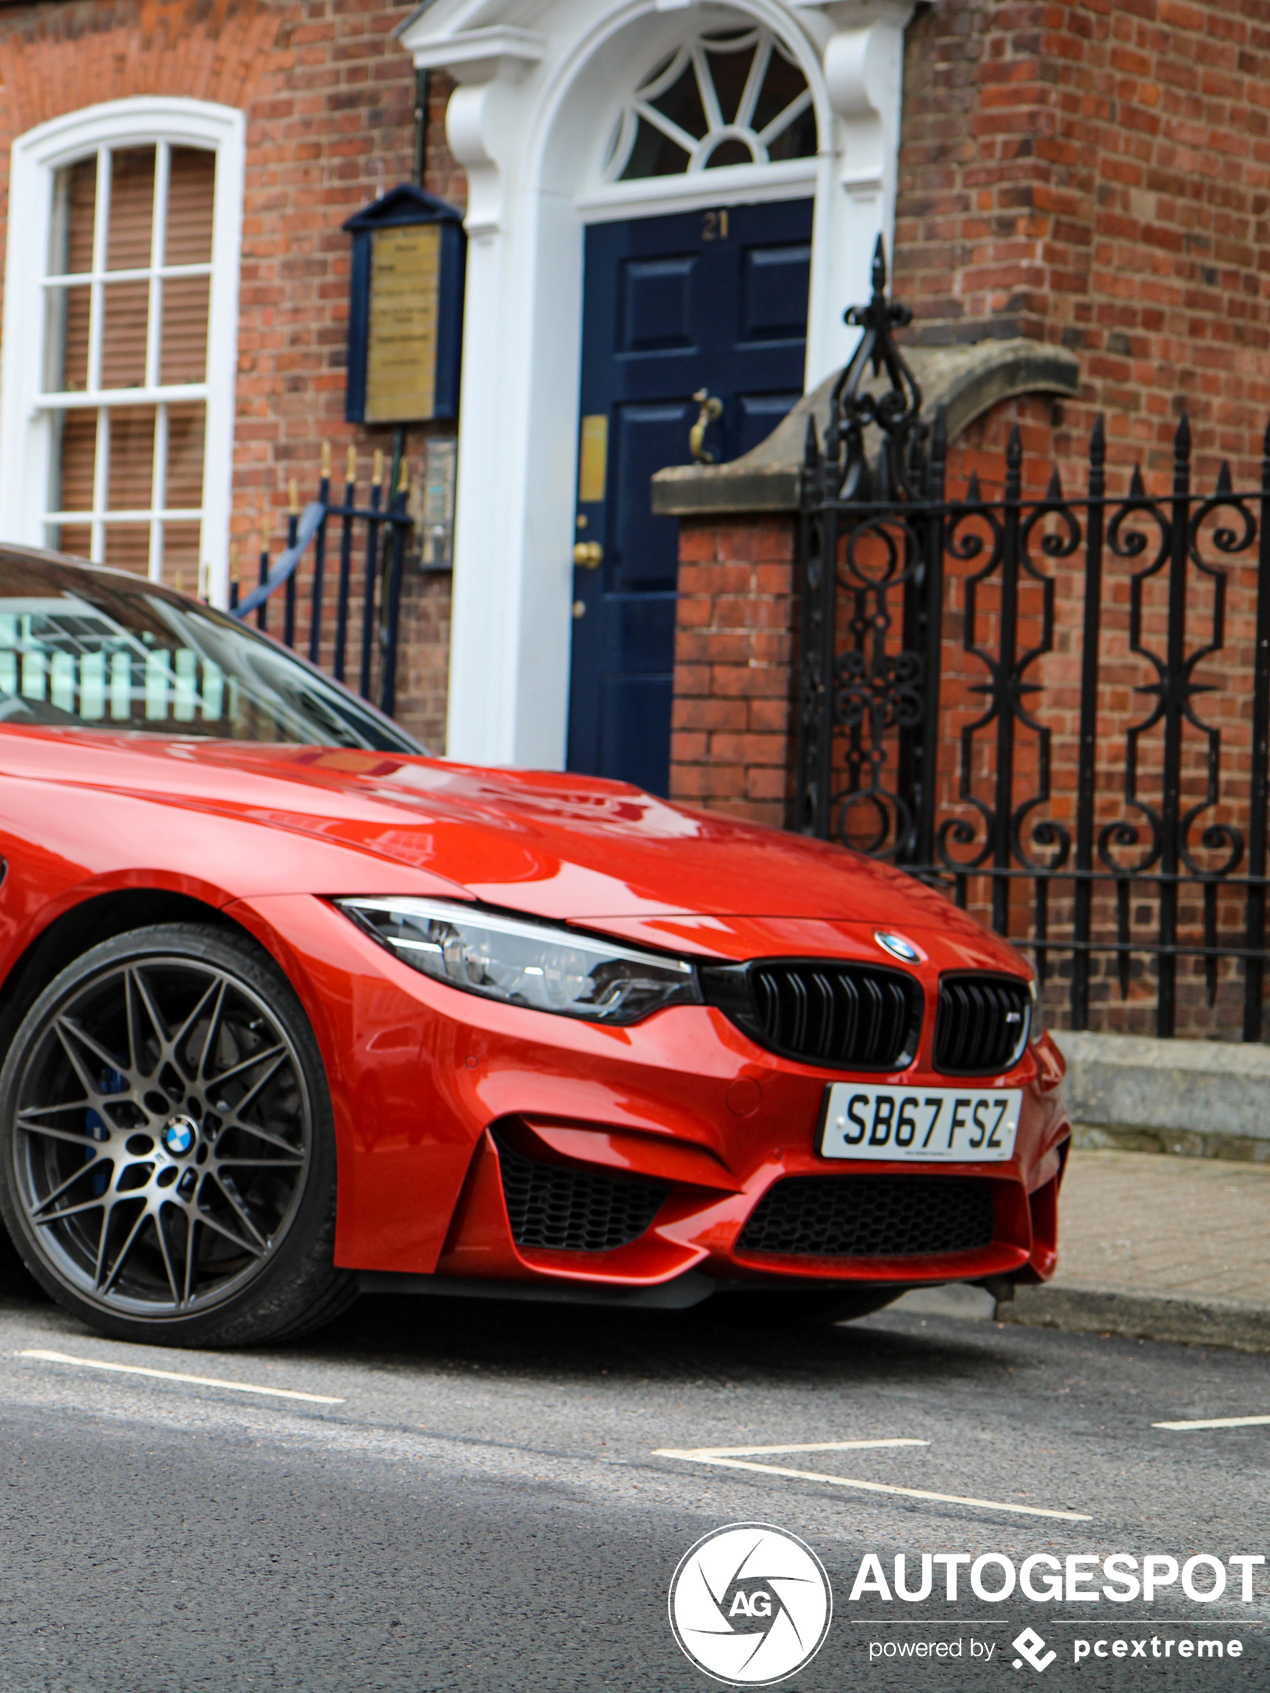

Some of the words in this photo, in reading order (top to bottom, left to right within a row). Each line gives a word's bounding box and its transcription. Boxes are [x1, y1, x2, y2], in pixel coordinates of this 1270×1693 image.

[701, 211, 728, 241] 21
[843, 1094, 943, 1147] SB67
[947, 1098, 1009, 1148] FSZ
